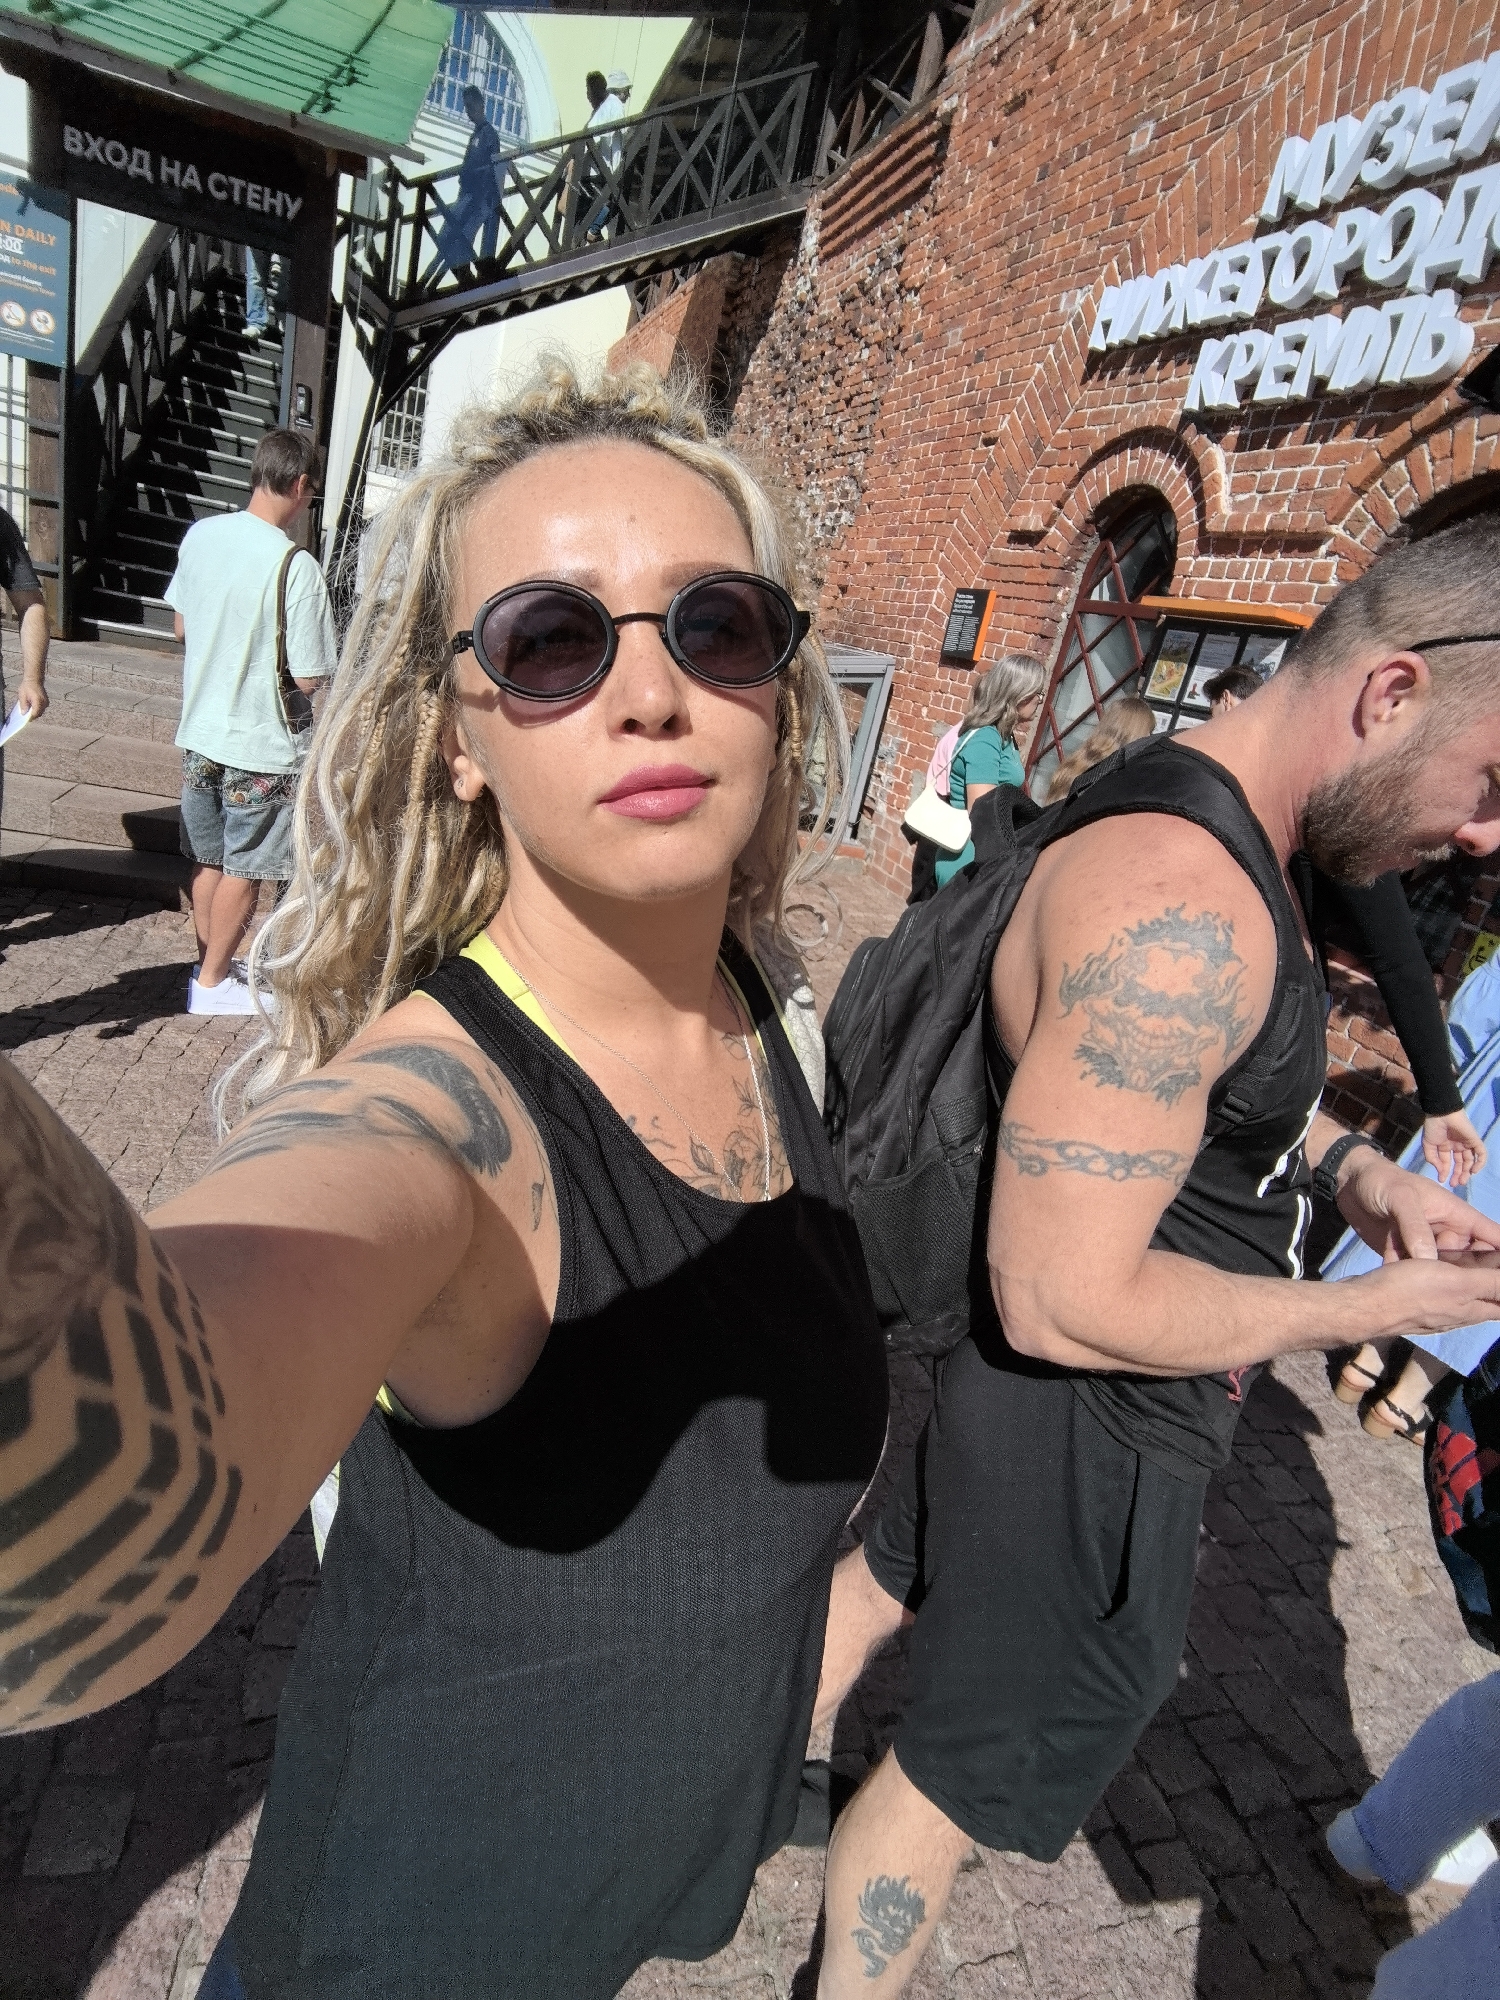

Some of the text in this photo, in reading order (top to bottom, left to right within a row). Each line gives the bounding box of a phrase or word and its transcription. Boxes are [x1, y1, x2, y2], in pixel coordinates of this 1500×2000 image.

[62, 124, 303, 221] ВХОД НА СТЕНУ
[14, 224, 56, 246] DAILY
[1087, 163, 1500, 353] НИЖЕГОРОД
[1183, 288, 1475, 413] КРЕМЛЬ
